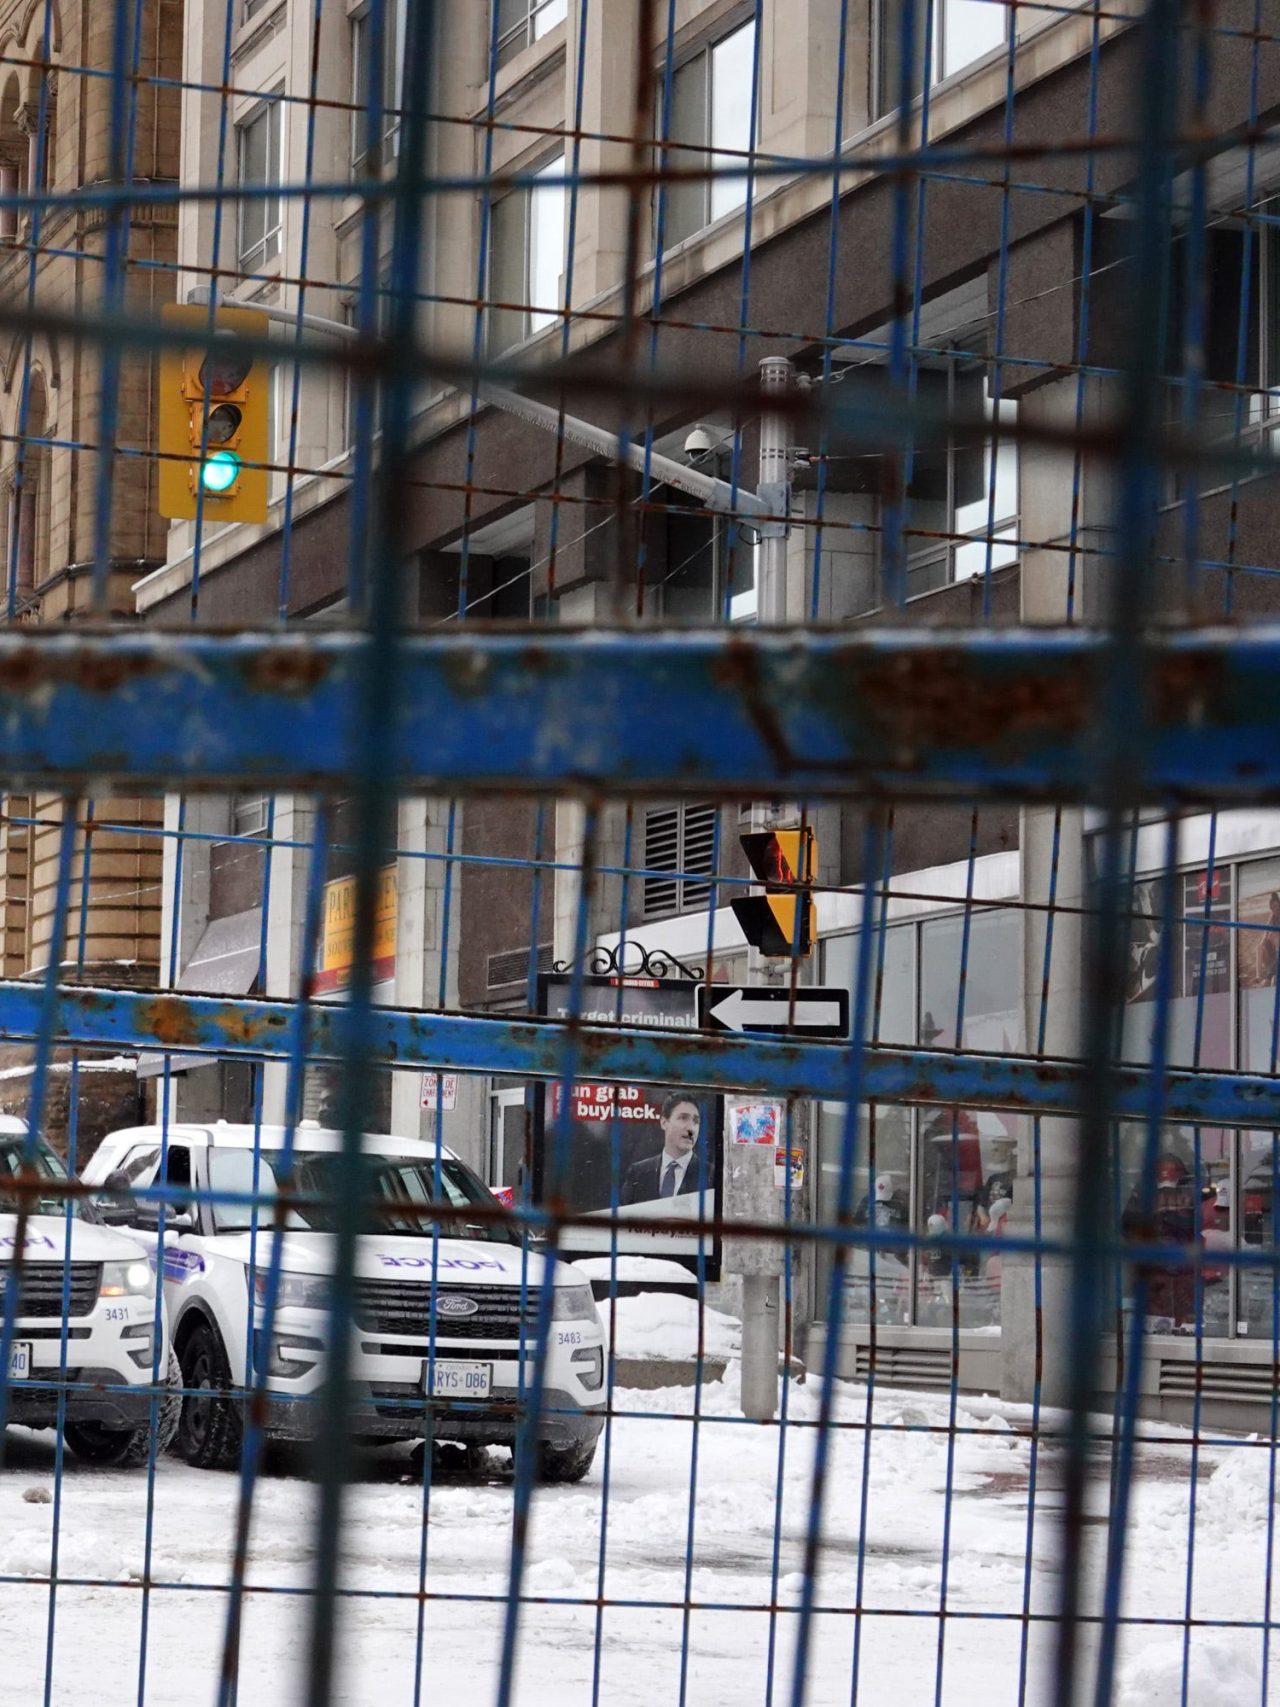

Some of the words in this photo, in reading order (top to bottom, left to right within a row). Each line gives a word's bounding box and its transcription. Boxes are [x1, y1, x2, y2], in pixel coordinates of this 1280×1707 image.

[557, 1007, 616, 1022] Trget
[596, 1086, 639, 1103] grab
[443, 1298, 468, 1311] Ford
[105, 1308, 129, 1321] 3431
[558, 1332, 581, 1345] 3483
[8, 1353, 26, 1370] 40
[433, 1371, 458, 1388] RYS
